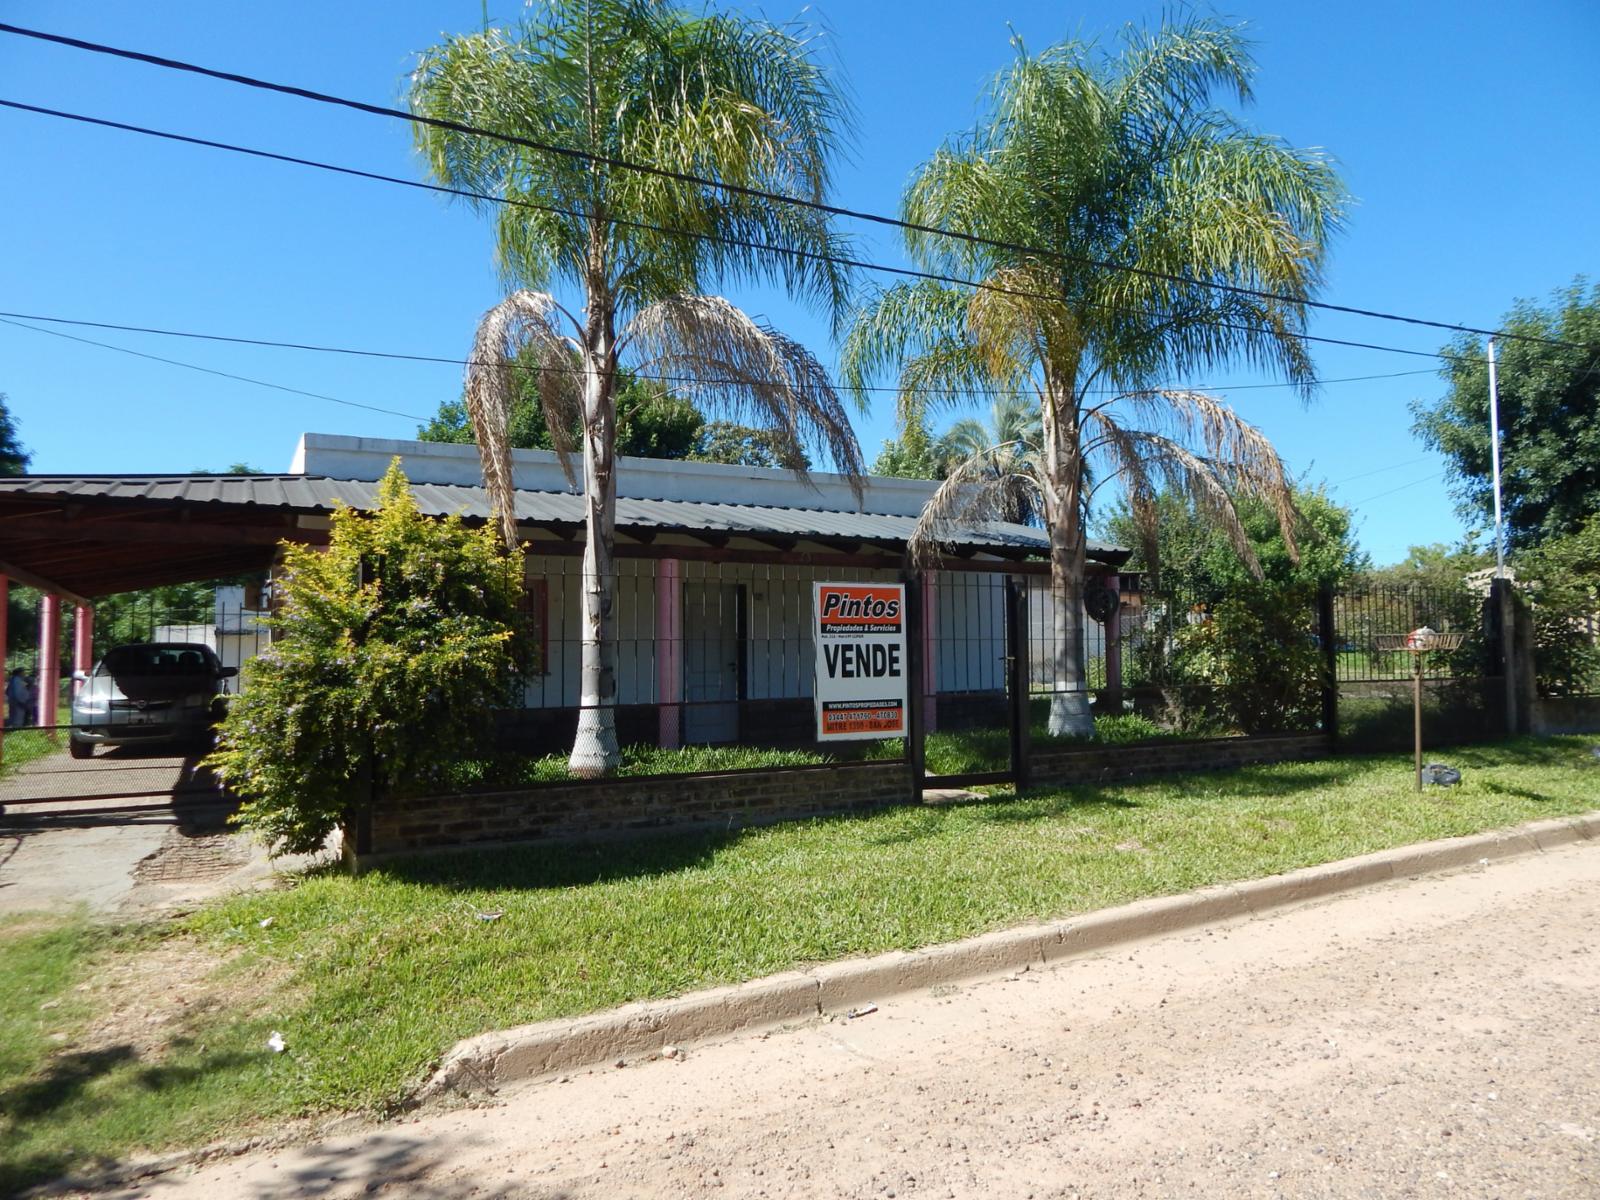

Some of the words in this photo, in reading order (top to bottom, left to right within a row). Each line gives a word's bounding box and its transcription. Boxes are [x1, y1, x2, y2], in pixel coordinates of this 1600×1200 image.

[822, 592, 901, 618] Pintos
[826, 624, 863, 632] Propiedades
[823, 643, 901, 678] VENDE
